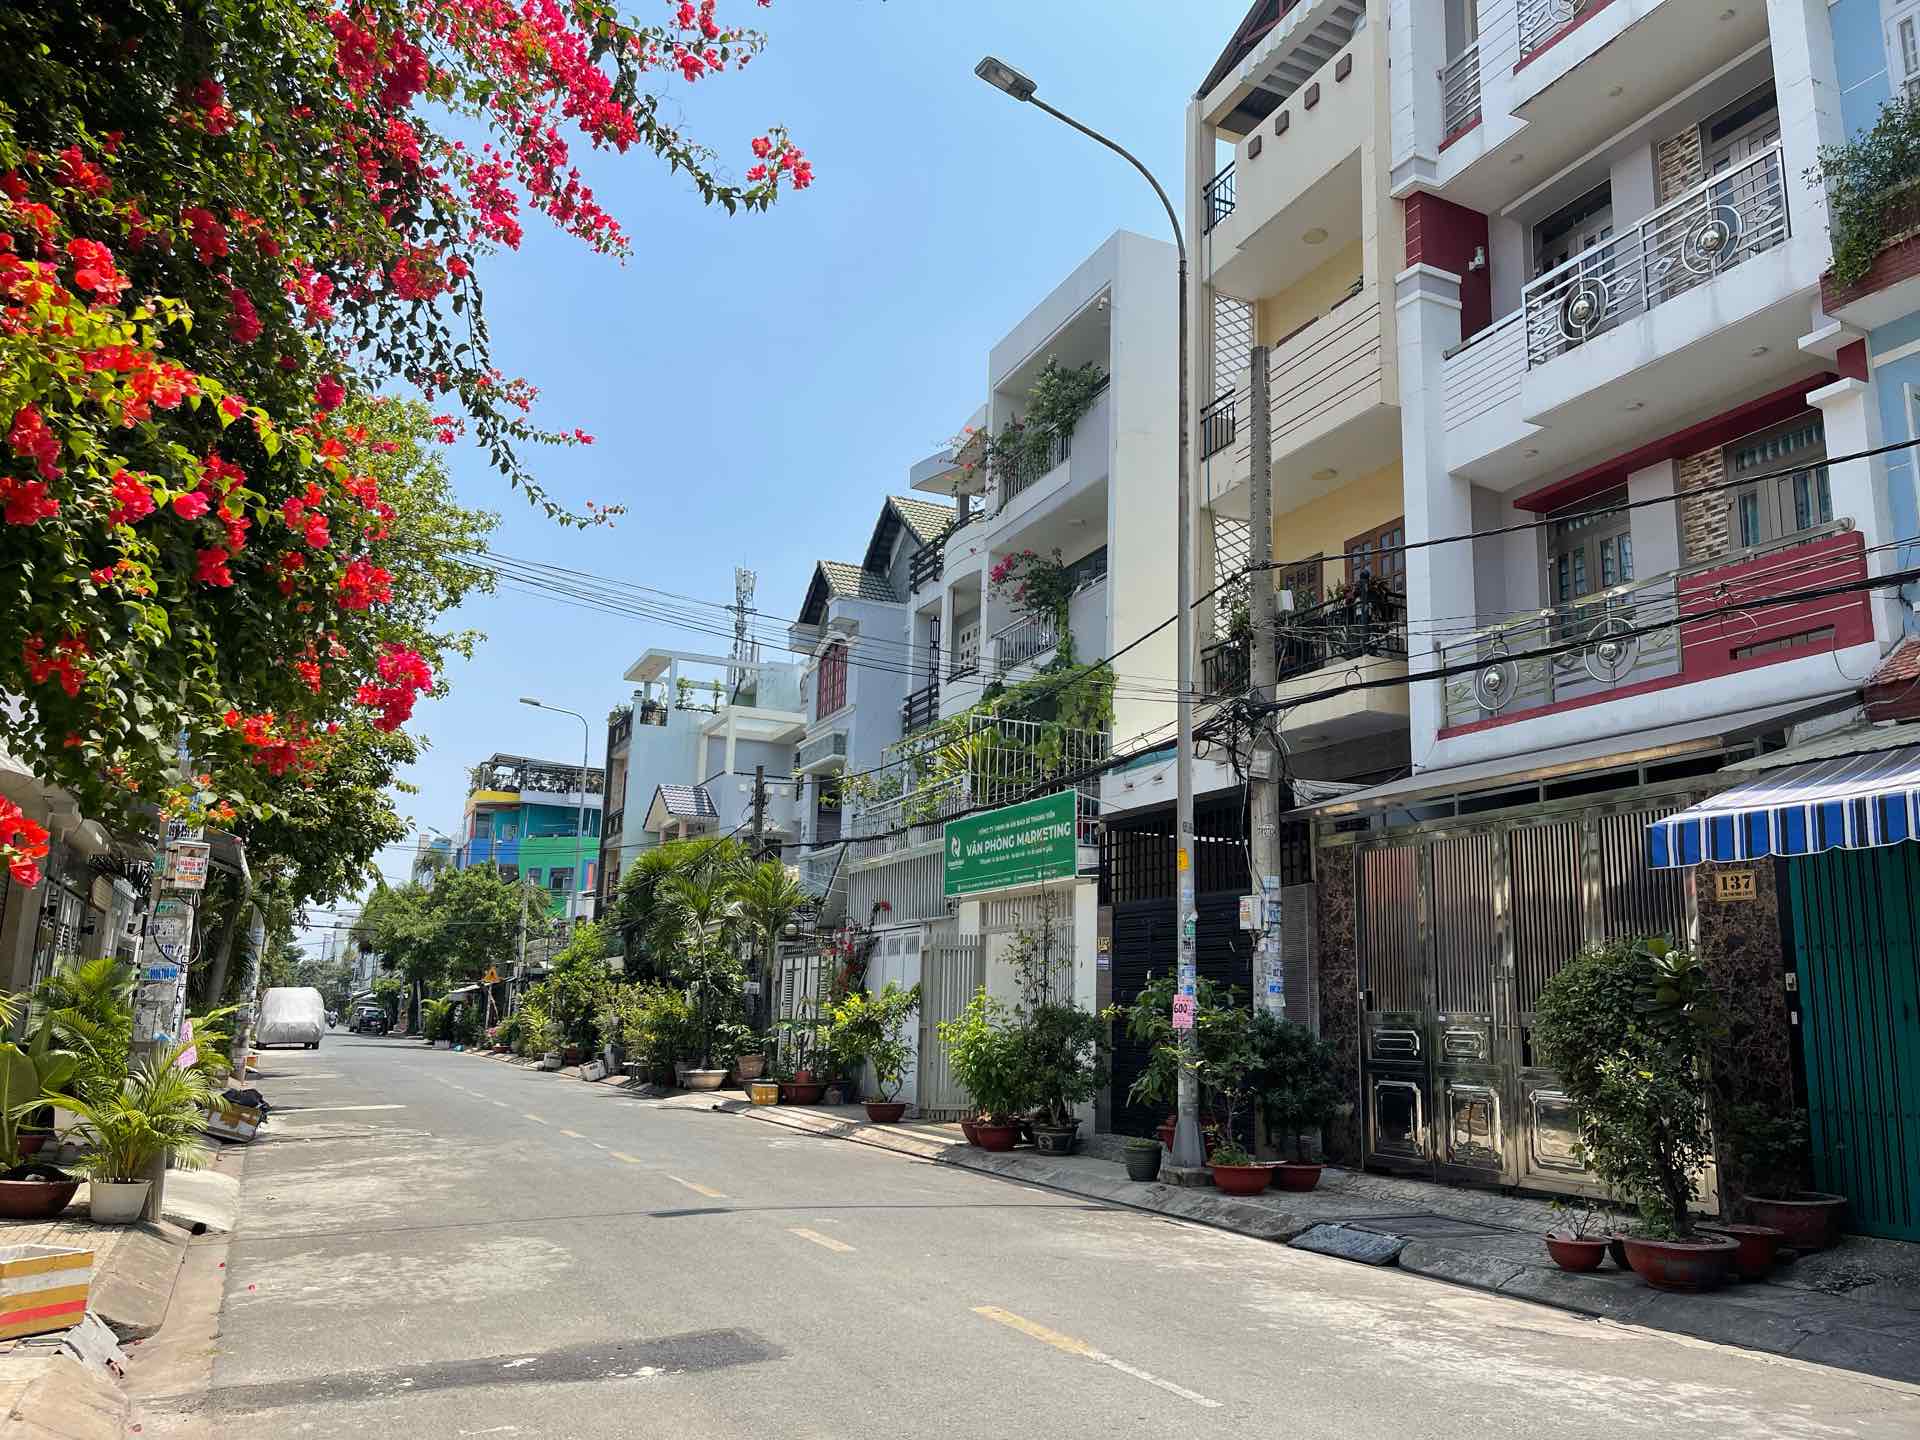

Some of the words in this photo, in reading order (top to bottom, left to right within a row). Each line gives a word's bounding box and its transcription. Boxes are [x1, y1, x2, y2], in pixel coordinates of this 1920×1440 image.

[966, 840, 983, 857] VĂN
[985, 834, 1014, 854] PHÒNG
[1016, 822, 1071, 845] MARKETING
[1721, 875, 1751, 890] 137
